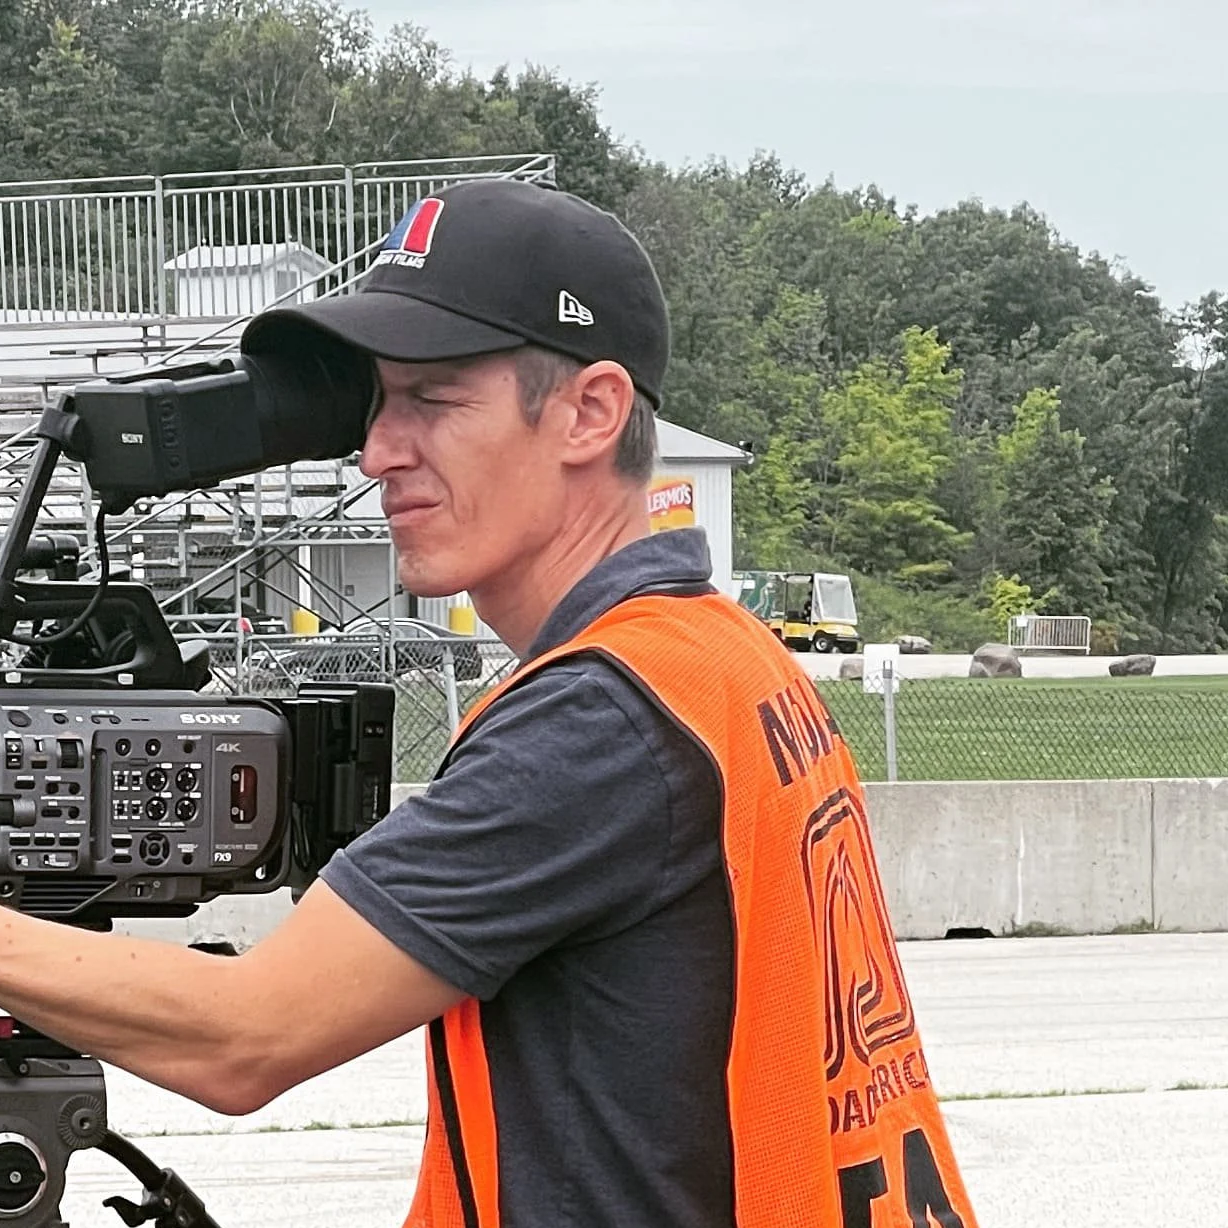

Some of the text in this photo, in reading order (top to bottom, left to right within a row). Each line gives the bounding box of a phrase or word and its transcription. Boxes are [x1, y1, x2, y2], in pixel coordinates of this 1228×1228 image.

[122, 433, 143, 443] SONY
[648, 484, 692, 512] LERMO'S
[180, 713, 241, 724] SONY
[215, 742, 242, 753] 4K
[214, 852, 232, 862] FX9
